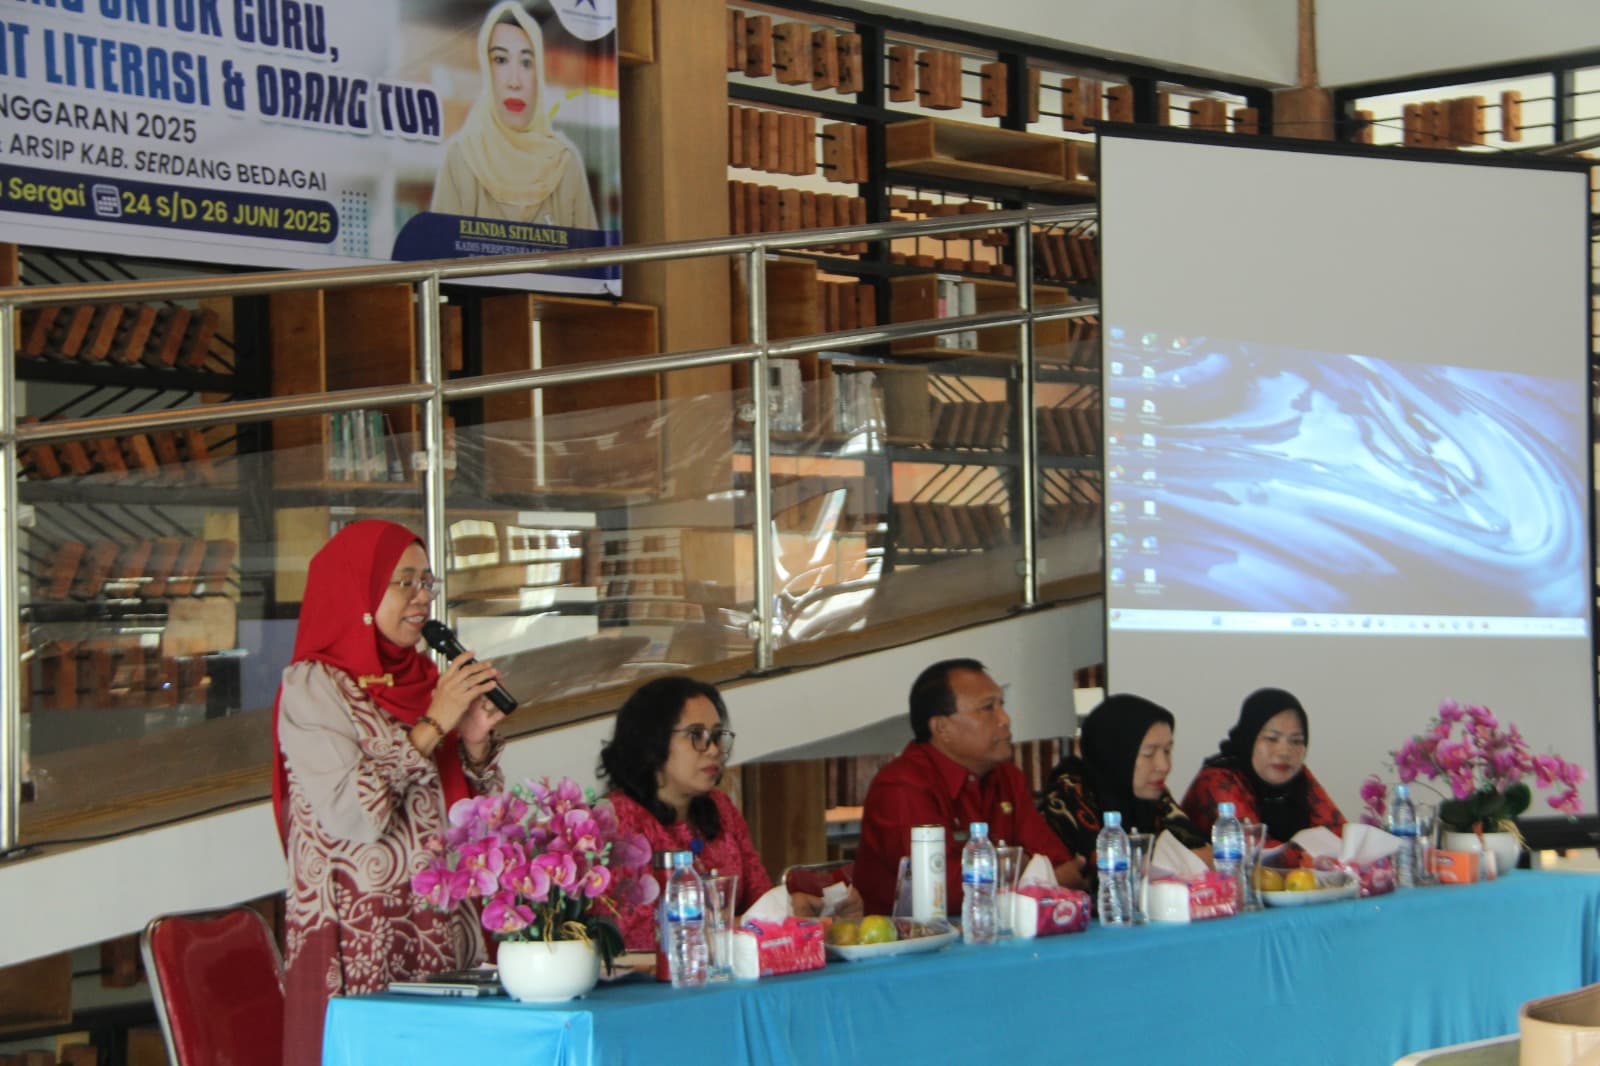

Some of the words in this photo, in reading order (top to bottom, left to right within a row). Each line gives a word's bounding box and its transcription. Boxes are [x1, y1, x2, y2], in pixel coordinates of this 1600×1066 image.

[233, 0, 339, 63] GURU,
[44, 28, 211, 107] LITERASI
[221, 59, 246, 112] &
[256, 64, 368, 129] ORANG
[377, 83, 441, 137] TUA
[136, 112, 197, 144] 2025
[9, 133, 75, 161] ARSIP
[81, 142, 129, 170] KAB.
[135, 150, 232, 181] SERDANG
[236, 163, 327, 191] BEDAGAI
[8, 176, 86, 213] Sergai
[122, 191, 152, 216] 24
[156, 191, 198, 223] S/D
[201, 199, 229, 223] 26
[232, 204, 280, 229] JUNI
[283, 208, 331, 234] 2025
[459, 219, 507, 239] ELINDA
[508, 224, 568, 245] SITIANUR
